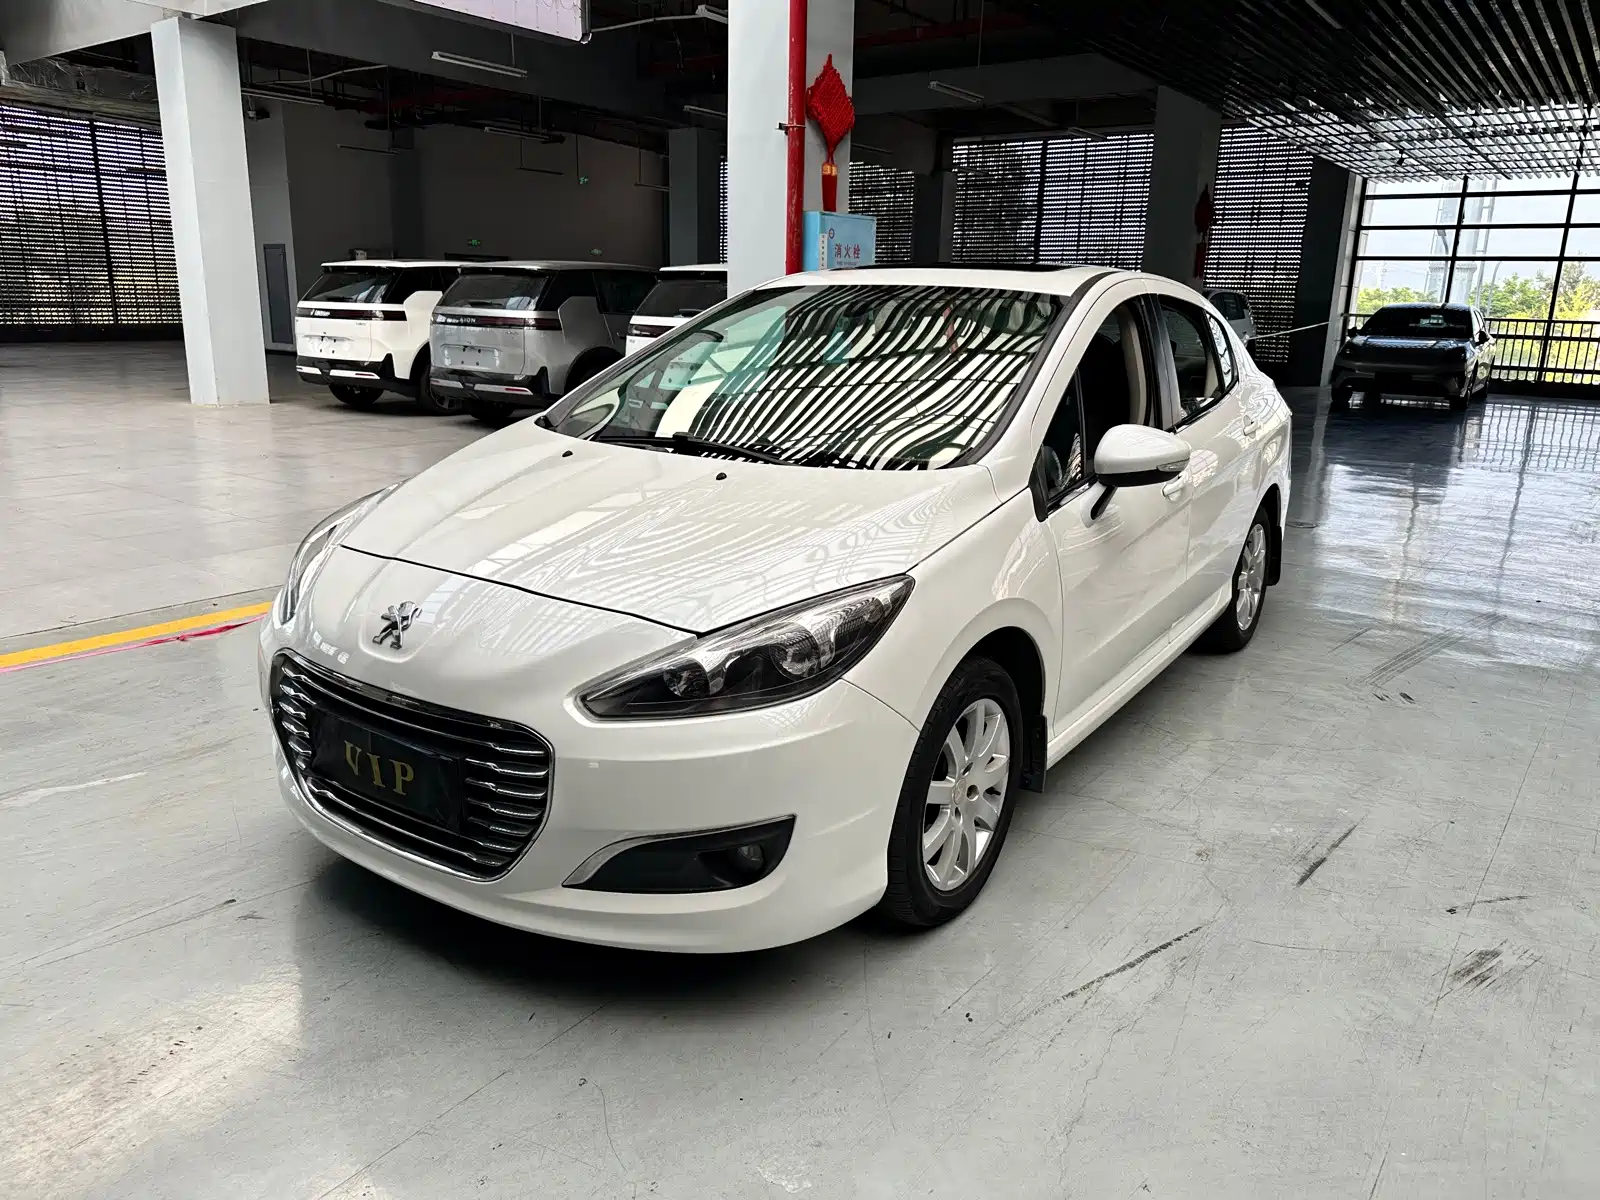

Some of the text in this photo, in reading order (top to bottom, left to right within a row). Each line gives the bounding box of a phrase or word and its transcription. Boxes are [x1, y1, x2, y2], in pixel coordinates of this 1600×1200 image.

[834, 243, 861, 259] 消火栓
[344, 740, 415, 796] VIP
